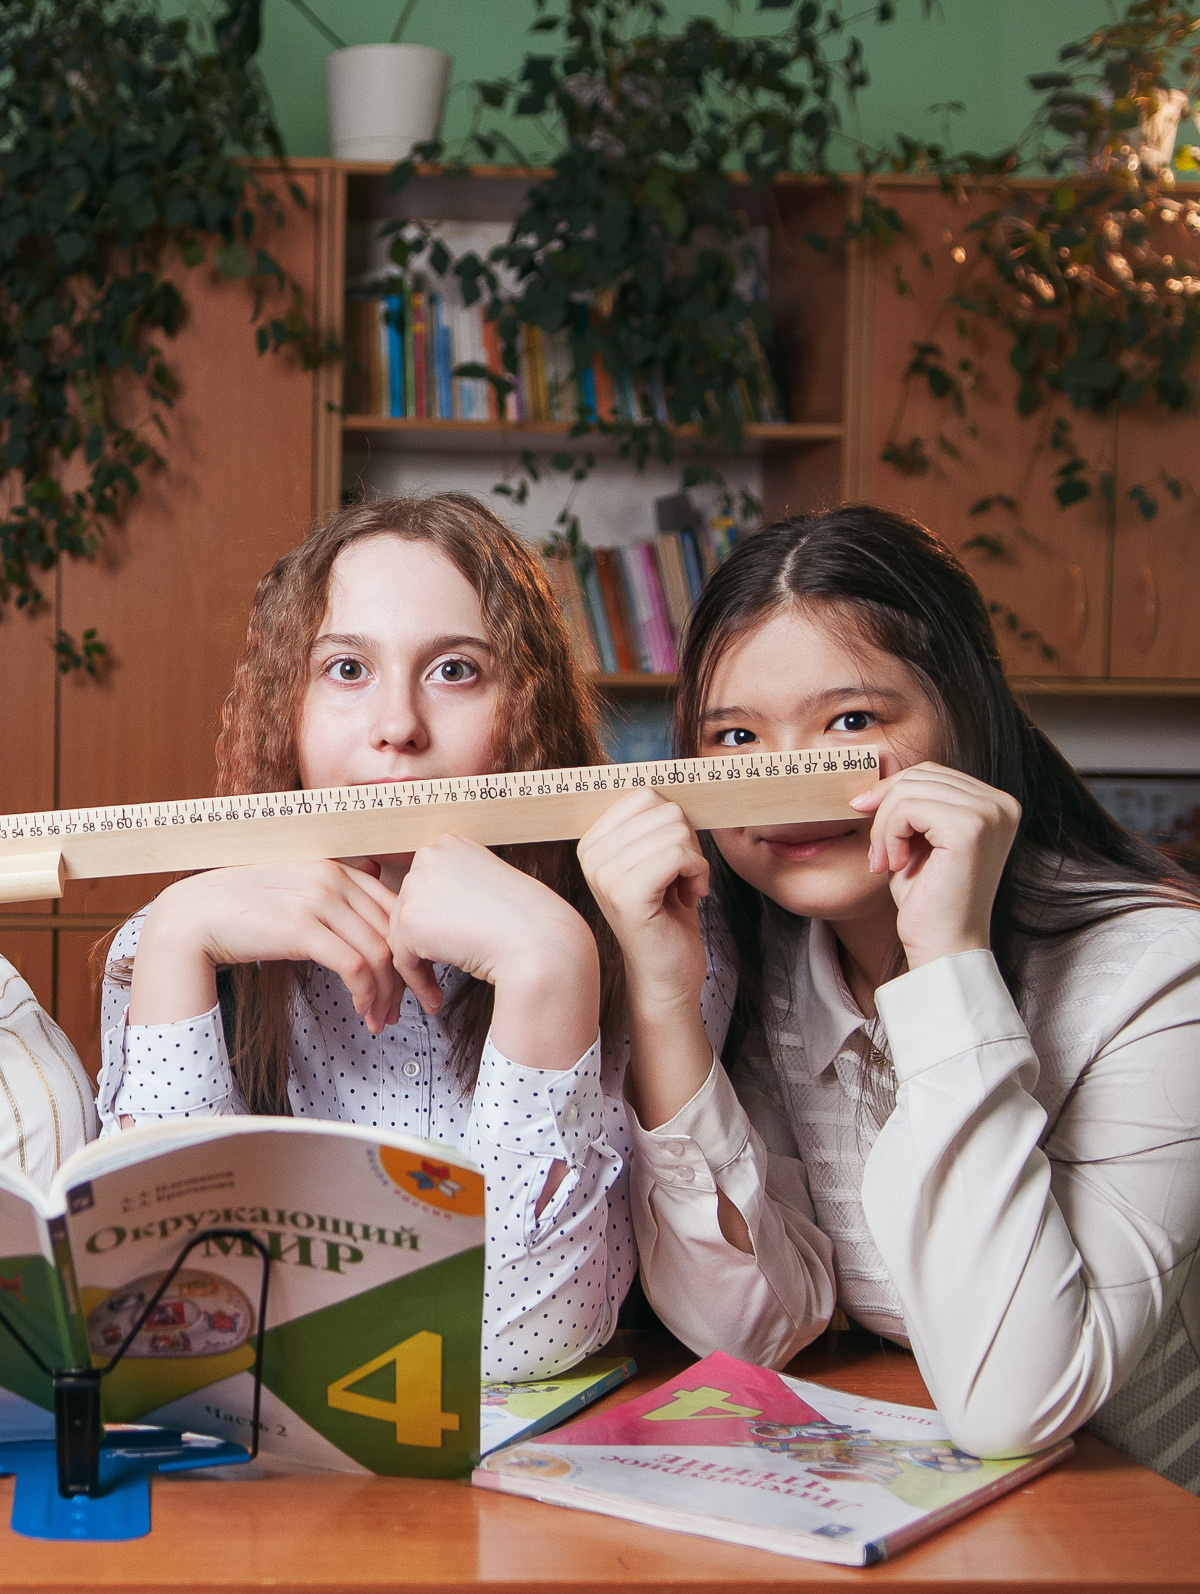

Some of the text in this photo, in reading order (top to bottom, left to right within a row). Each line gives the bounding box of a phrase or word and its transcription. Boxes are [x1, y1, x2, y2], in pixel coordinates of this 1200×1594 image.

[12, 829, 24, 838] 54
[30, 827, 43, 836] 55
[47, 825, 60, 835] 56
[65, 824, 77, 833] 57
[82, 822, 96, 832] 58
[100, 821, 114, 830] 59
[116, 818, 132, 829] 60
[136, 818, 148, 828] 61
[154, 817, 167, 826] 62
[172, 815, 185, 825] 63
[190, 814, 203, 823] 64
[208, 812, 222, 822] 65
[225, 811, 239, 820] 66
[243, 809, 256, 819] 67
[261, 808, 275, 817] 68
[280, 806, 293, 816] 69
[297, 802, 312, 814] 70
[315, 803, 328, 813] 71
[334, 801, 347, 811] 72
[352, 800, 366, 809] 73
[370, 798, 383, 808] 74
[389, 797, 402, 806] 75
[408, 795, 421, 805] 76
[426, 793, 438, 803] 77
[444, 792, 457, 802] 78
[463, 790, 477, 800] 79
[479, 788, 497, 799] 80
[499, 788, 512, 797] 81
[519, 786, 532, 796] 82
[537, 785, 551, 794] 83
[556, 783, 569, 793] 84
[575, 781, 589, 791] 85
[593, 780, 607, 790] 86
[613, 778, 626, 788] 87
[632, 777, 646, 787] 88
[651, 775, 664, 785] 89
[667, 772, 685, 783] 90
[688, 772, 700, 782] 91
[707, 771, 721, 780] 92
[726, 769, 741, 779] 93
[746, 768, 760, 778] 94
[765, 766, 779, 776] 95
[784, 764, 799, 774] 96
[804, 763, 818, 773] 97
[823, 761, 837, 771] 98
[843, 760, 857, 770] 99
[857, 757, 877, 770] 100
[85, 1205, 422, 1256] Окружающий
[327, 1330, 460, 1448] 4
[641, 1385, 764, 1421] 4
[275, 1424, 288, 1438] 2
[873, 1409, 933, 1427] Часть
[600, 1454, 864, 1512] Литературное
[653, 1453, 832, 1494] ЧТЕНИЕ
